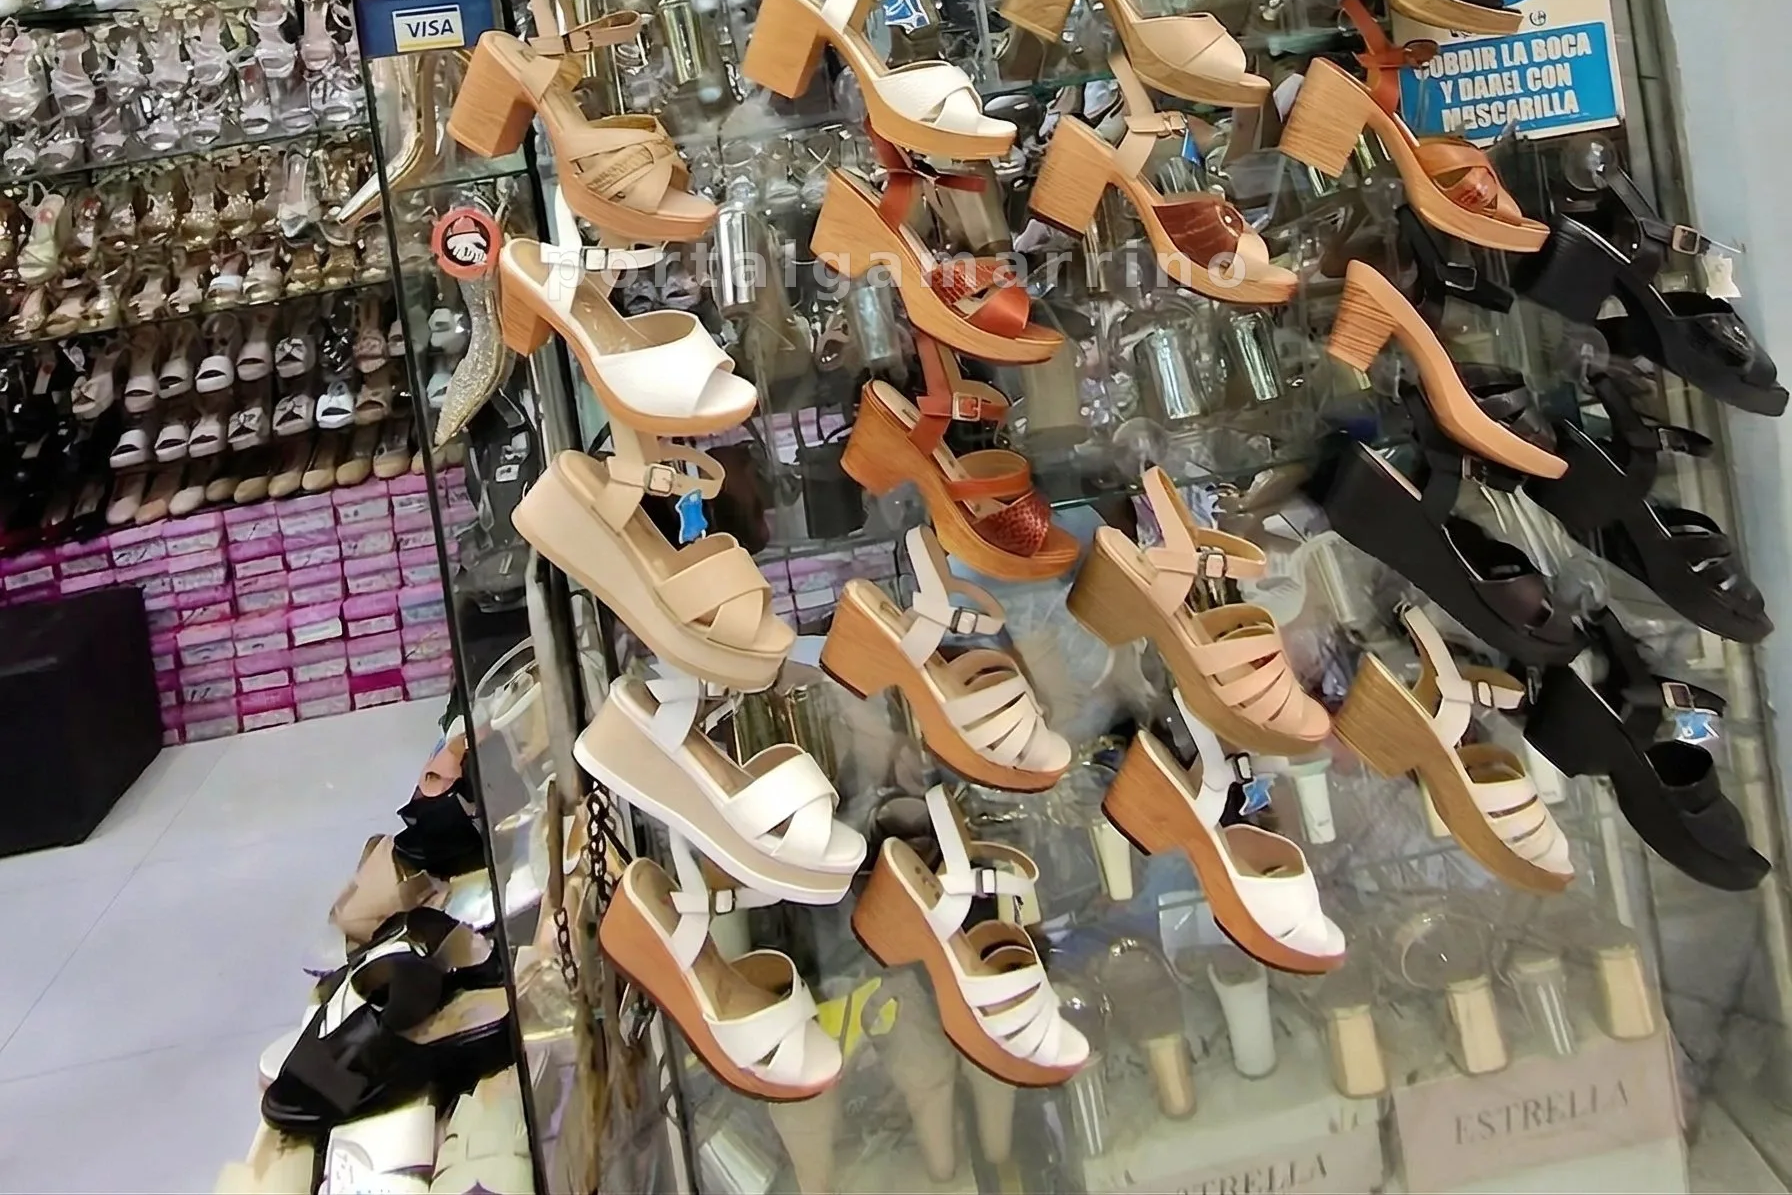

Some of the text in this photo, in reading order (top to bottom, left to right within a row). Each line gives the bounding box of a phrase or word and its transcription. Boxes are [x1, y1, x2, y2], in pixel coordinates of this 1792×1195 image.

[405, 19, 454, 38] VISA
[1500, 40, 1528, 67] LA
[1531, 32, 1592, 62] BOCA
[1439, 80, 1454, 104] Y
[1526, 62, 1573, 92] CON
[1454, 1080, 1629, 1145] ESTRELLA
